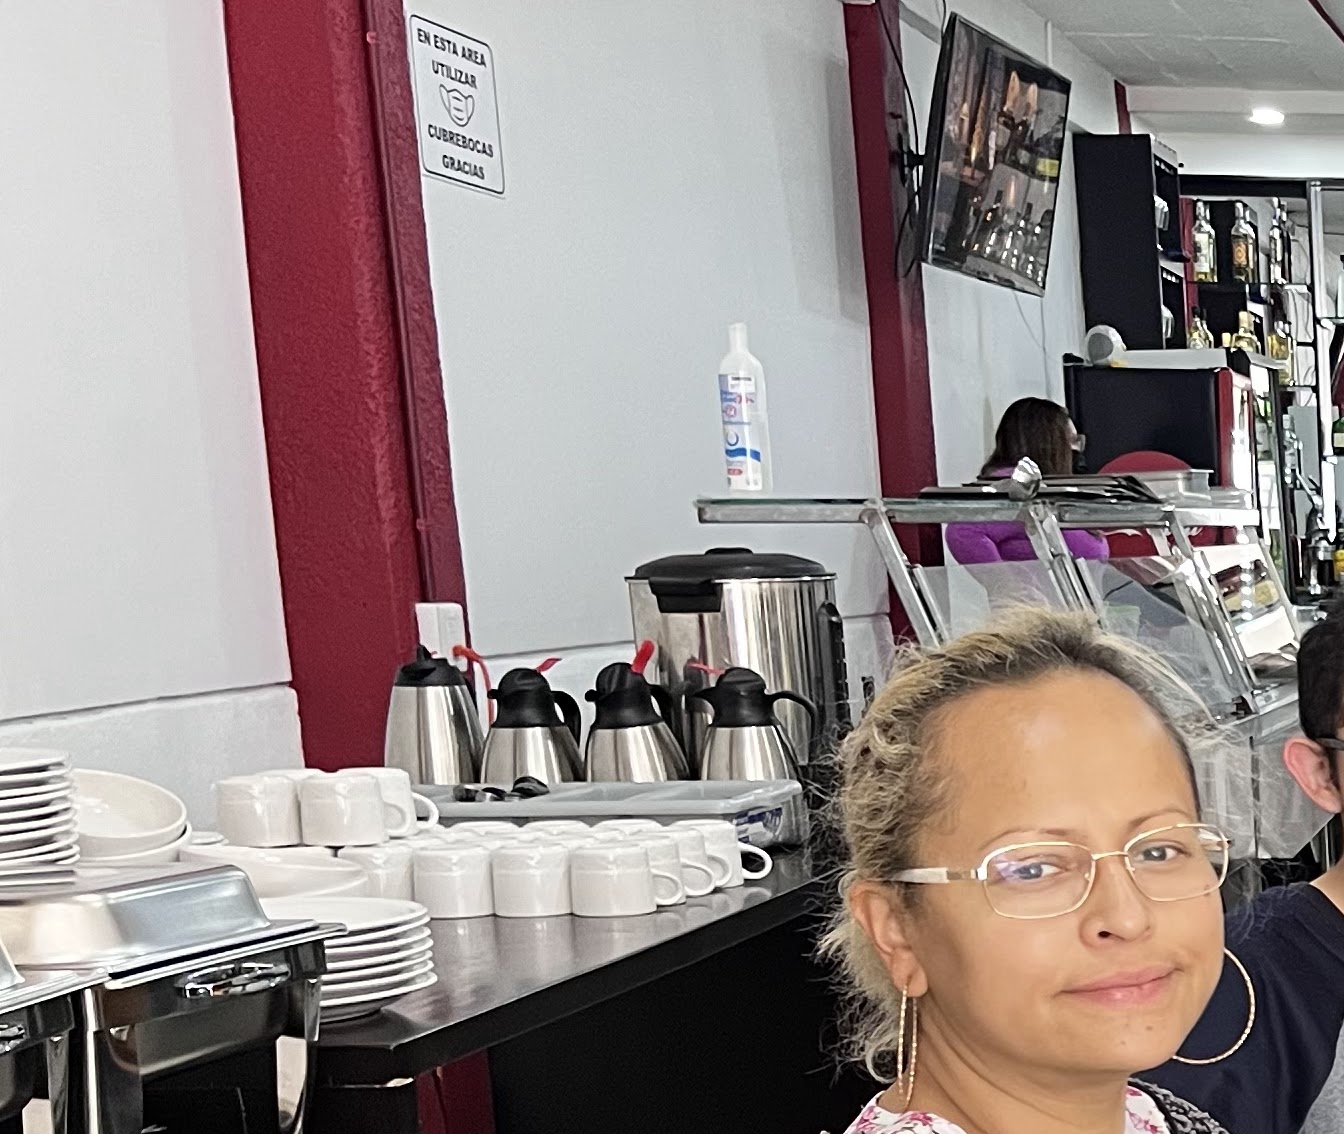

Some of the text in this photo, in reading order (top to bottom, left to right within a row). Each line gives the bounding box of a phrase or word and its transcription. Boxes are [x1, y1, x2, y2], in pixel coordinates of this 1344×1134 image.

[417, 28, 486, 68] EN ESTA AREA
[431, 60, 477, 89] UTILIZAR
[428, 124, 494, 158] CUBREBOCAS
[442, 155, 485, 181] GRACIAS
